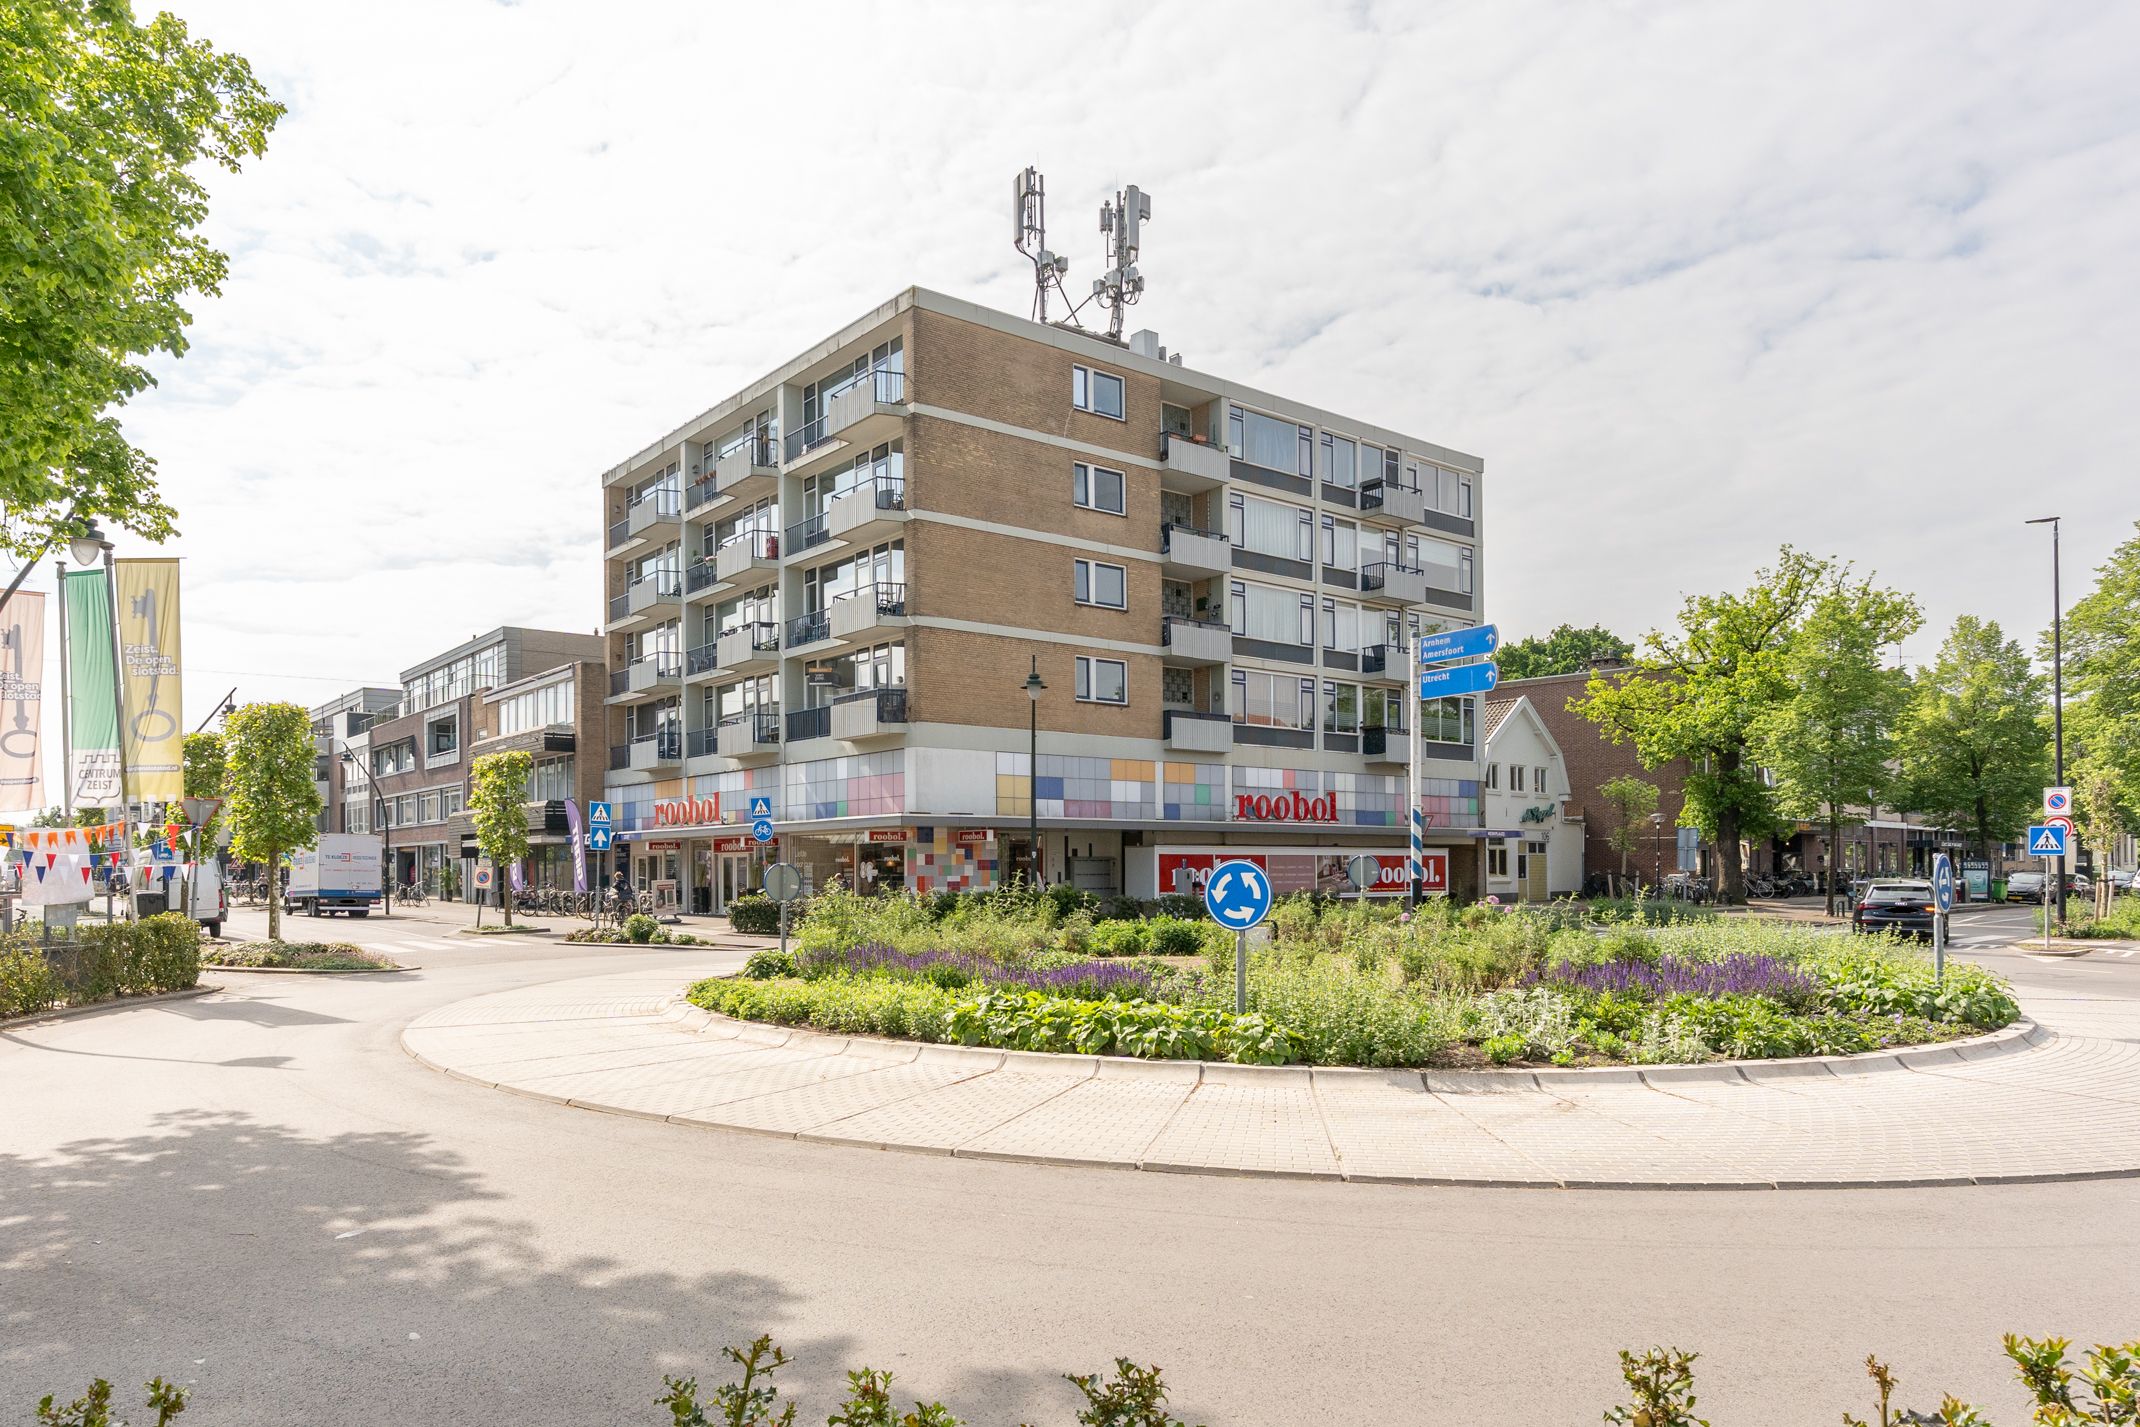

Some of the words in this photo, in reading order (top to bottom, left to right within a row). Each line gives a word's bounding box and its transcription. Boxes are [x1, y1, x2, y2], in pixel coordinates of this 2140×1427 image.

[1422, 636, 1451, 648] Arnhem
[124, 644, 158, 654] Zeist.
[1422, 645, 1465, 659] Amersfoort
[1422, 672, 1450, 684] Utrecht
[10, 682, 39, 692] open
[87, 780, 112, 790] ZEIST
[654, 791, 720, 827] roobol
[1235, 790, 1339, 822] roobol
[873, 832, 904, 841] roobol.
[962, 831, 985, 840] roobol.
